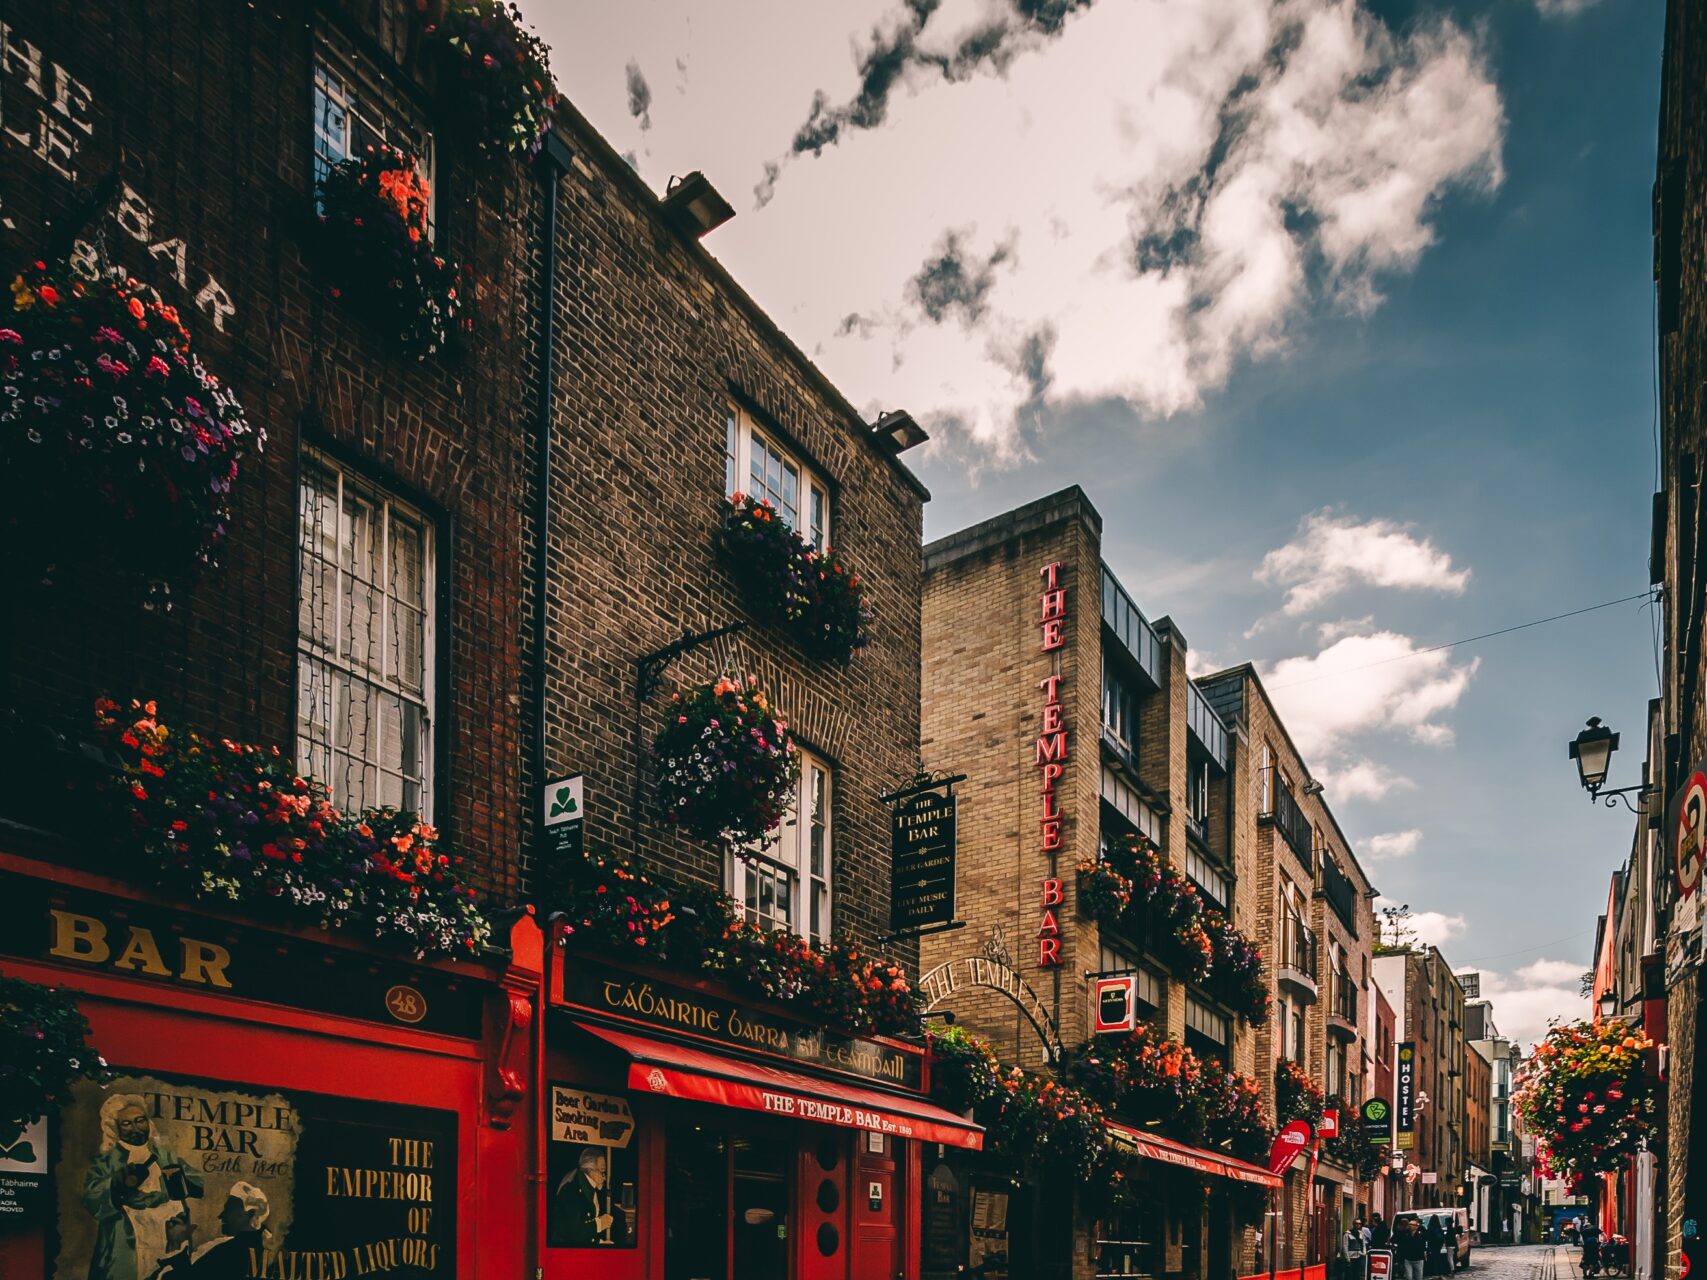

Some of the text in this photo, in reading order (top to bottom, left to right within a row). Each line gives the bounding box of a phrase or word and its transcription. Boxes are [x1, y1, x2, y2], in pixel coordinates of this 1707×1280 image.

[117, 182, 235, 333] BAR
[1039, 561, 1065, 652] THE
[1036, 674, 1068, 853] TEMPLE
[896, 807, 953, 829] TEMPLE
[915, 799, 933, 810] THE
[908, 826, 939, 842] BAR
[917, 856, 951, 870] GARDEN
[918, 891, 948, 904] MUSIC
[1038, 878, 1064, 969] BAR
[49, 908, 233, 989] BAR
[924, 962, 961, 1004] THE
[966, 958, 1026, 1005] TEMPLE
[391, 991, 417, 1014] 48
[144, 1092, 294, 1132] TEMPLE
[763, 1092, 794, 1113] THE
[798, 1099, 853, 1124] TEMPLE
[855, 1110, 881, 1130] BAR
[1401, 1063, 1411, 1127] HOSTEL
[555, 1107, 600, 1130] Smoking
[564, 1126, 589, 1141] Area
[192, 1125, 263, 1159] BAR
[388, 1137, 434, 1169] THE
[326, 1166, 433, 1202] EMPEROR
[408, 1207, 433, 1234] OF
[247, 1237, 441, 1280] MALTED LIQUORS
